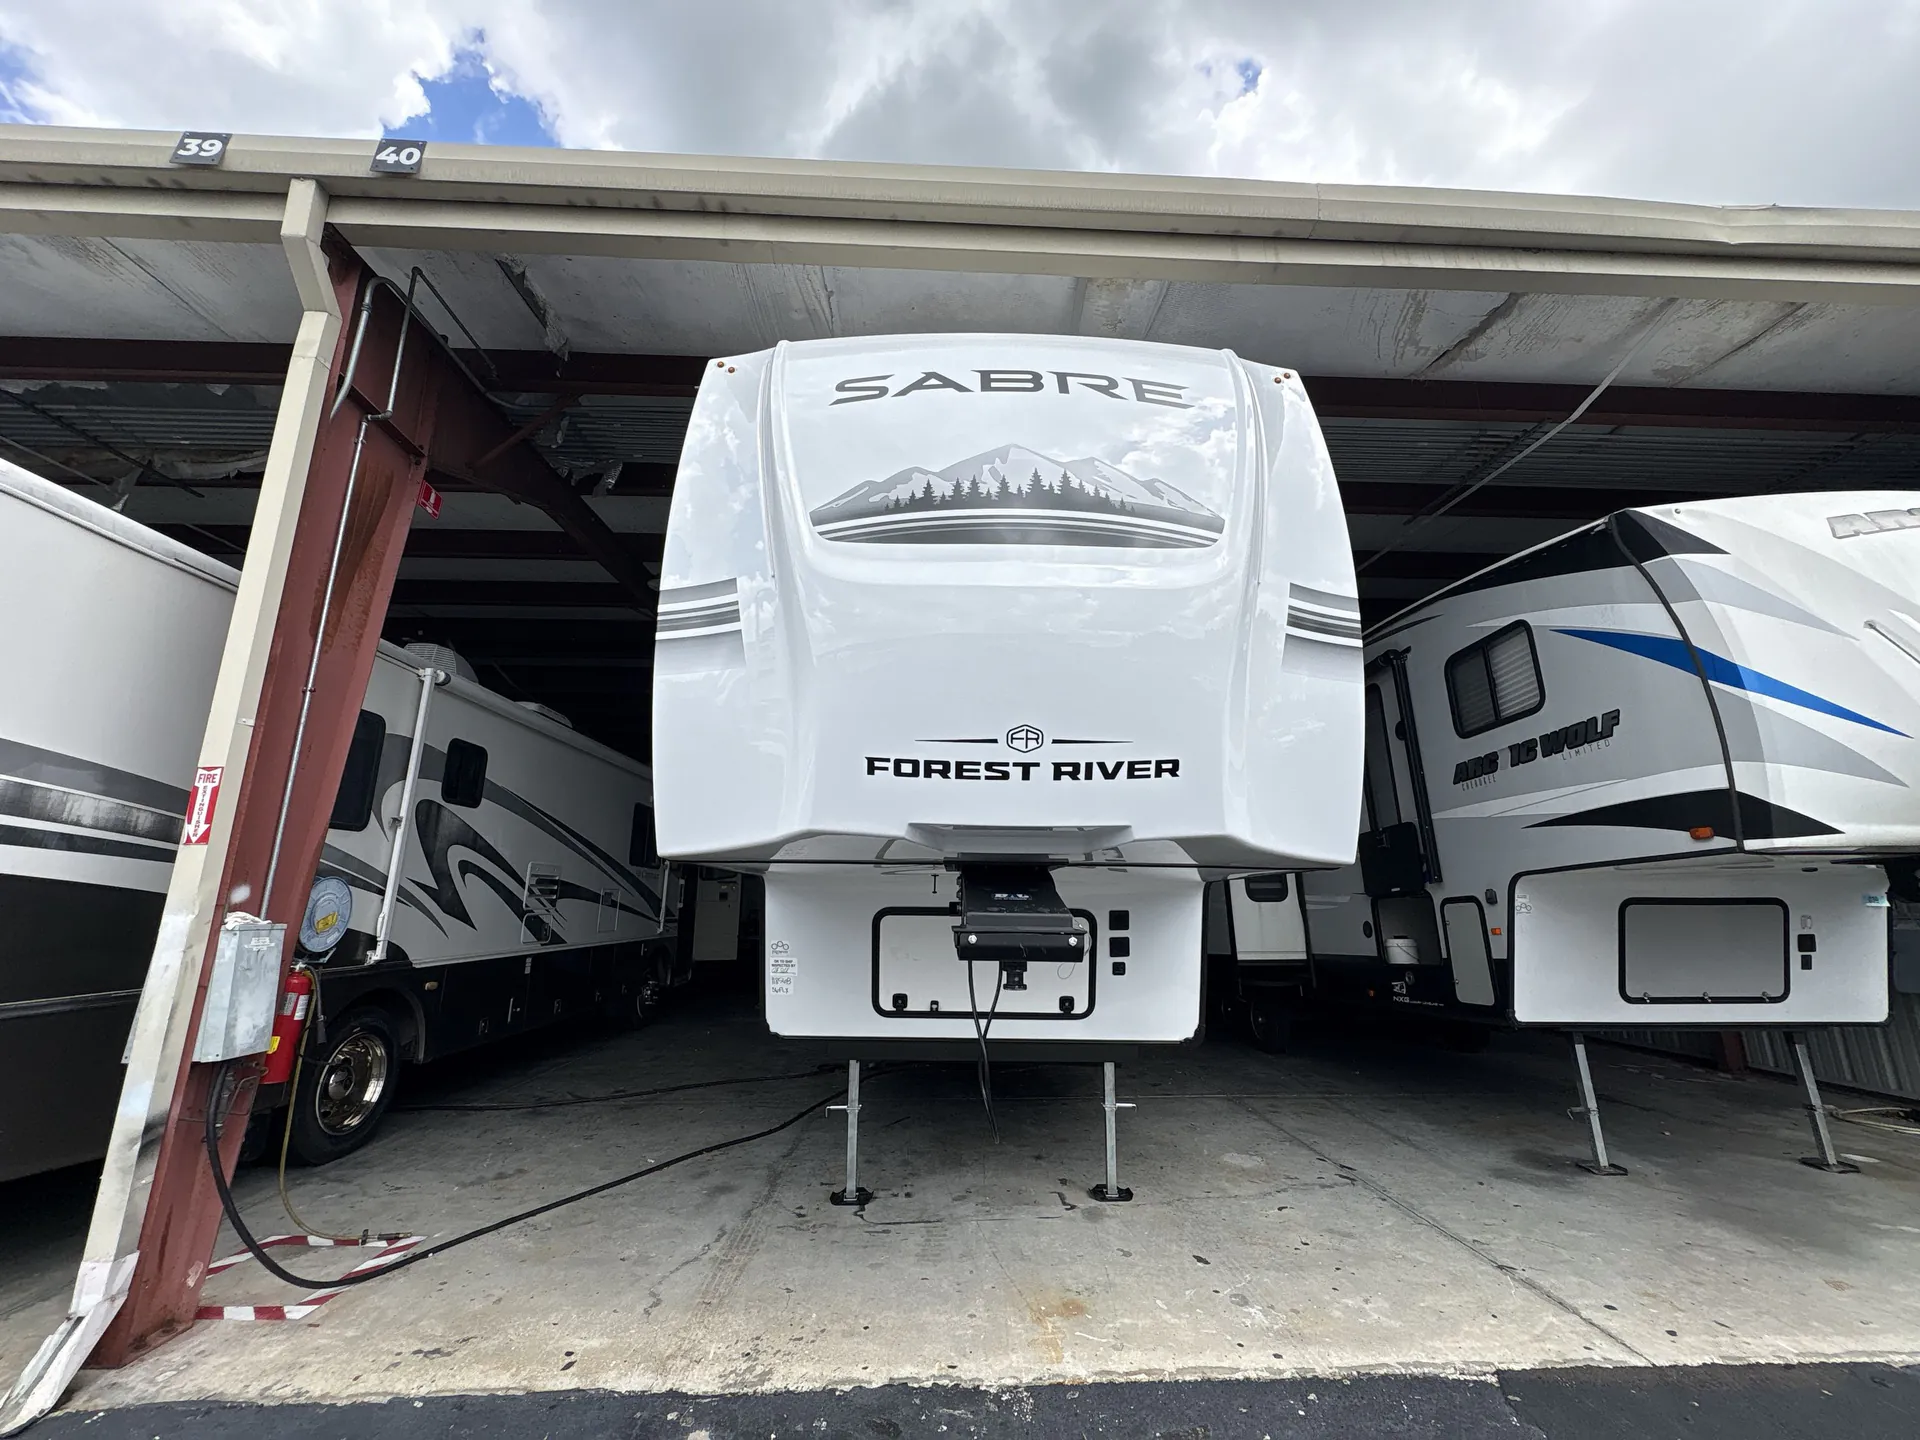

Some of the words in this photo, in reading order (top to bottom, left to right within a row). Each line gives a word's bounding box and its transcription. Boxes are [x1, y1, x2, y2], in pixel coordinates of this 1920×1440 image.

[177, 138, 223, 157] 39
[375, 146, 422, 165] 40
[829, 370, 1195, 409] SABRE
[1826, 508, 1920, 540] AR
[1539, 709, 1620, 758] WOLF
[1562, 739, 1611, 761] LIMITED
[197, 773, 218, 784] FIRE
[864, 756, 1040, 781] FOREST
[1051, 759, 1180, 781] RIVER
[1461, 774, 1497, 792] CHEROKEE
[192, 785, 208, 838] EXTINGUISHER
